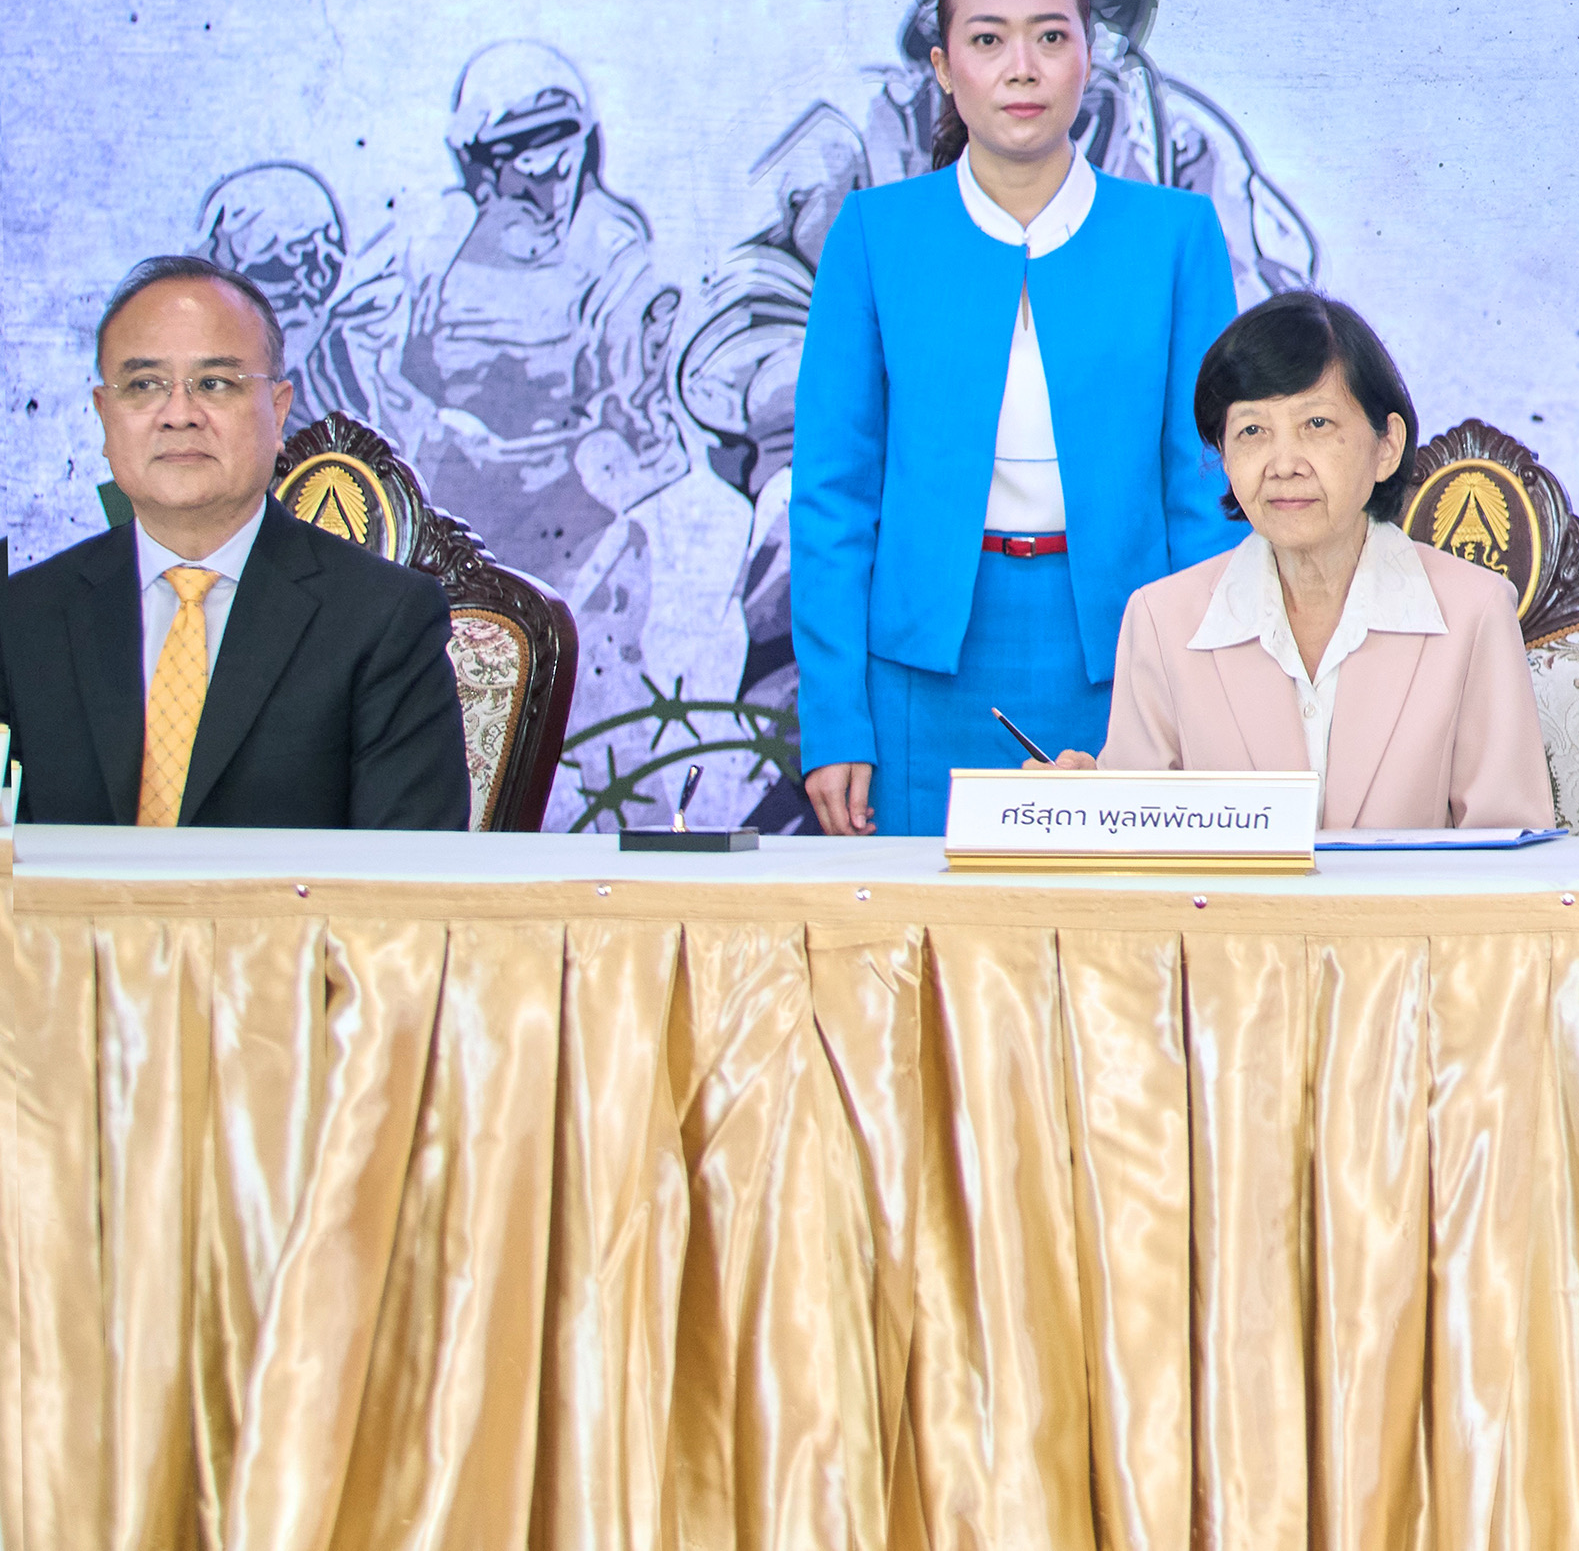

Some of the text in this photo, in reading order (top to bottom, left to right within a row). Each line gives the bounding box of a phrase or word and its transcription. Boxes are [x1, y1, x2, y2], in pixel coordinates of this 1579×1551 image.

[1001, 801, 1271, 834] ศรีสุดา พูลพิพัฒนันท์
